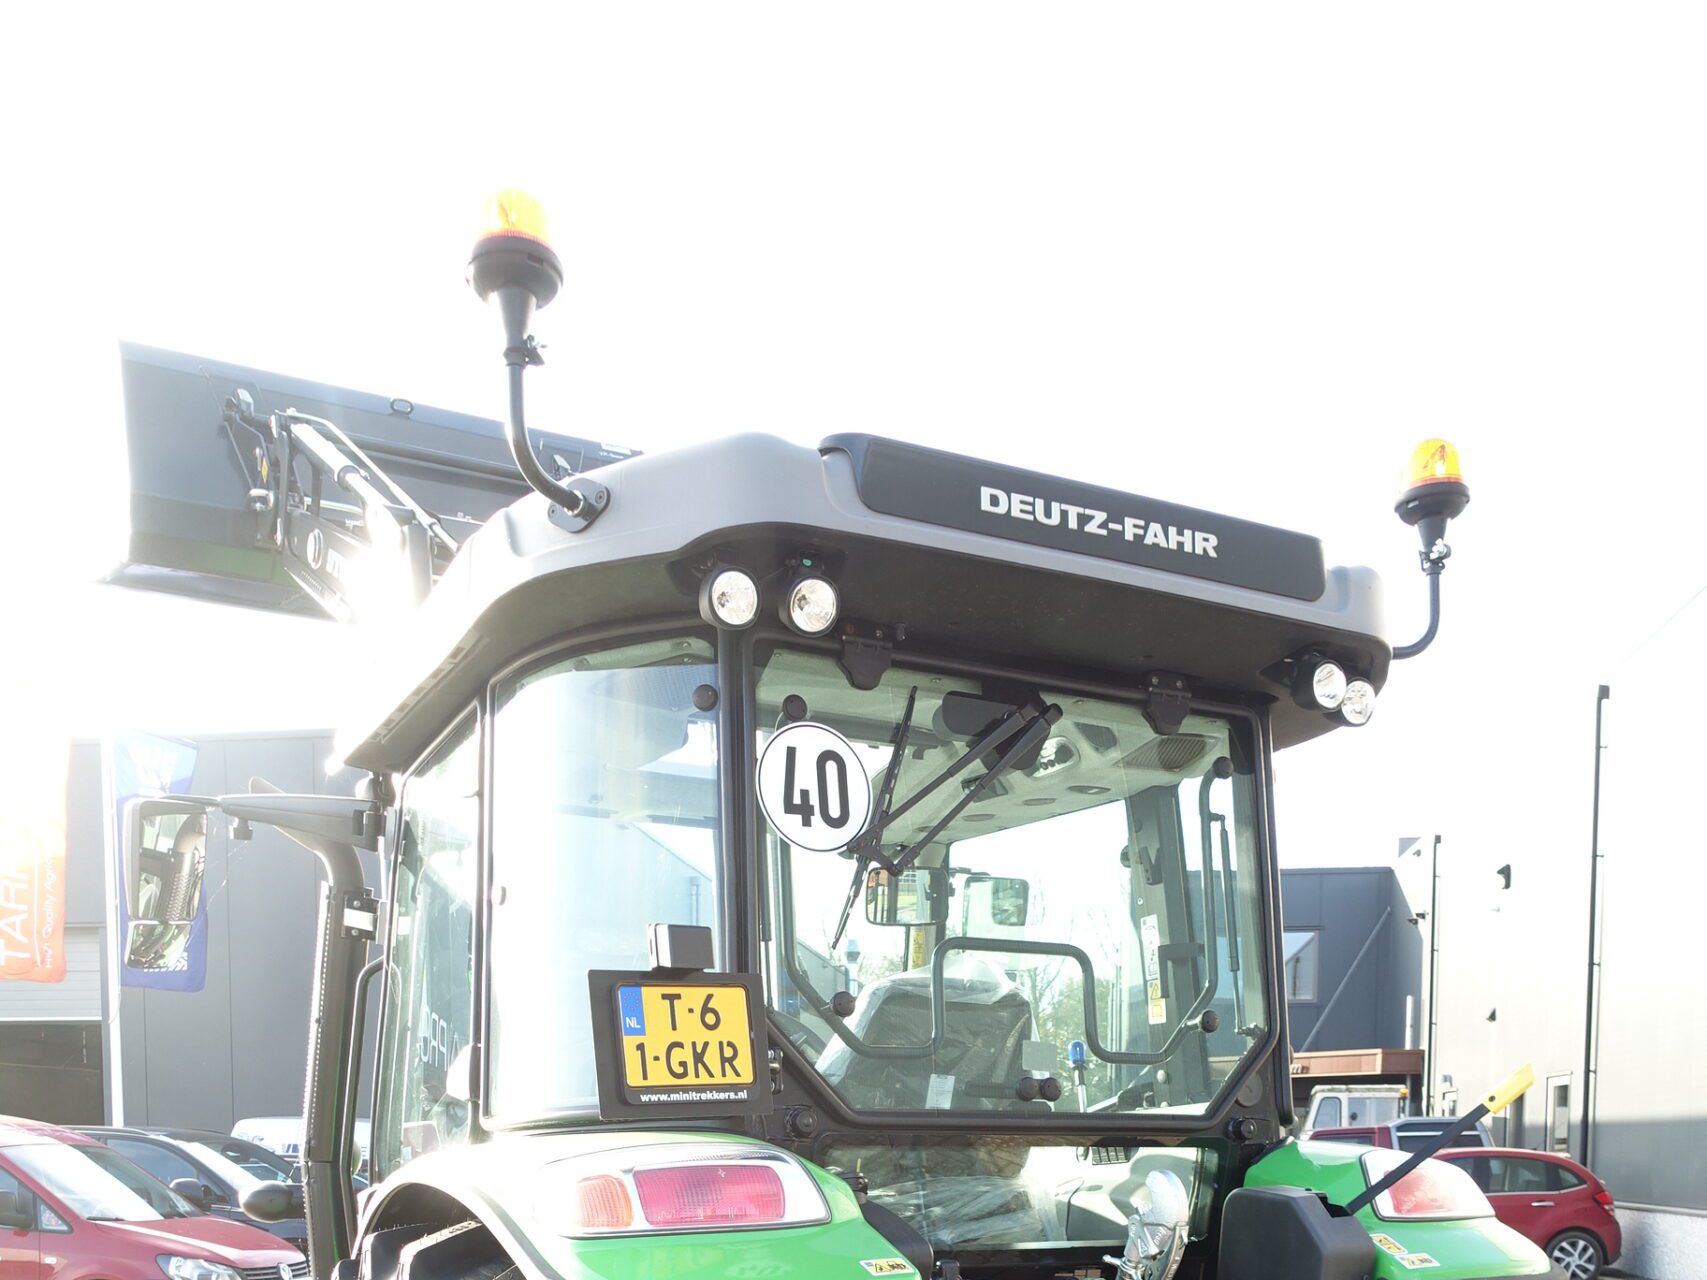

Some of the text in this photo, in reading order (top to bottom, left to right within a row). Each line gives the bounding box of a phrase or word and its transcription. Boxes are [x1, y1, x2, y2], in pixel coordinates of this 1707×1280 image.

[981, 486, 1218, 558] DEUTZ-FAHR
[783, 745, 850, 829] 40
[625, 1017, 641, 1029] NL
[636, 1041, 742, 1081] 1-GKR
[640, 1090, 748, 1102] www.minitrekkers.nl
